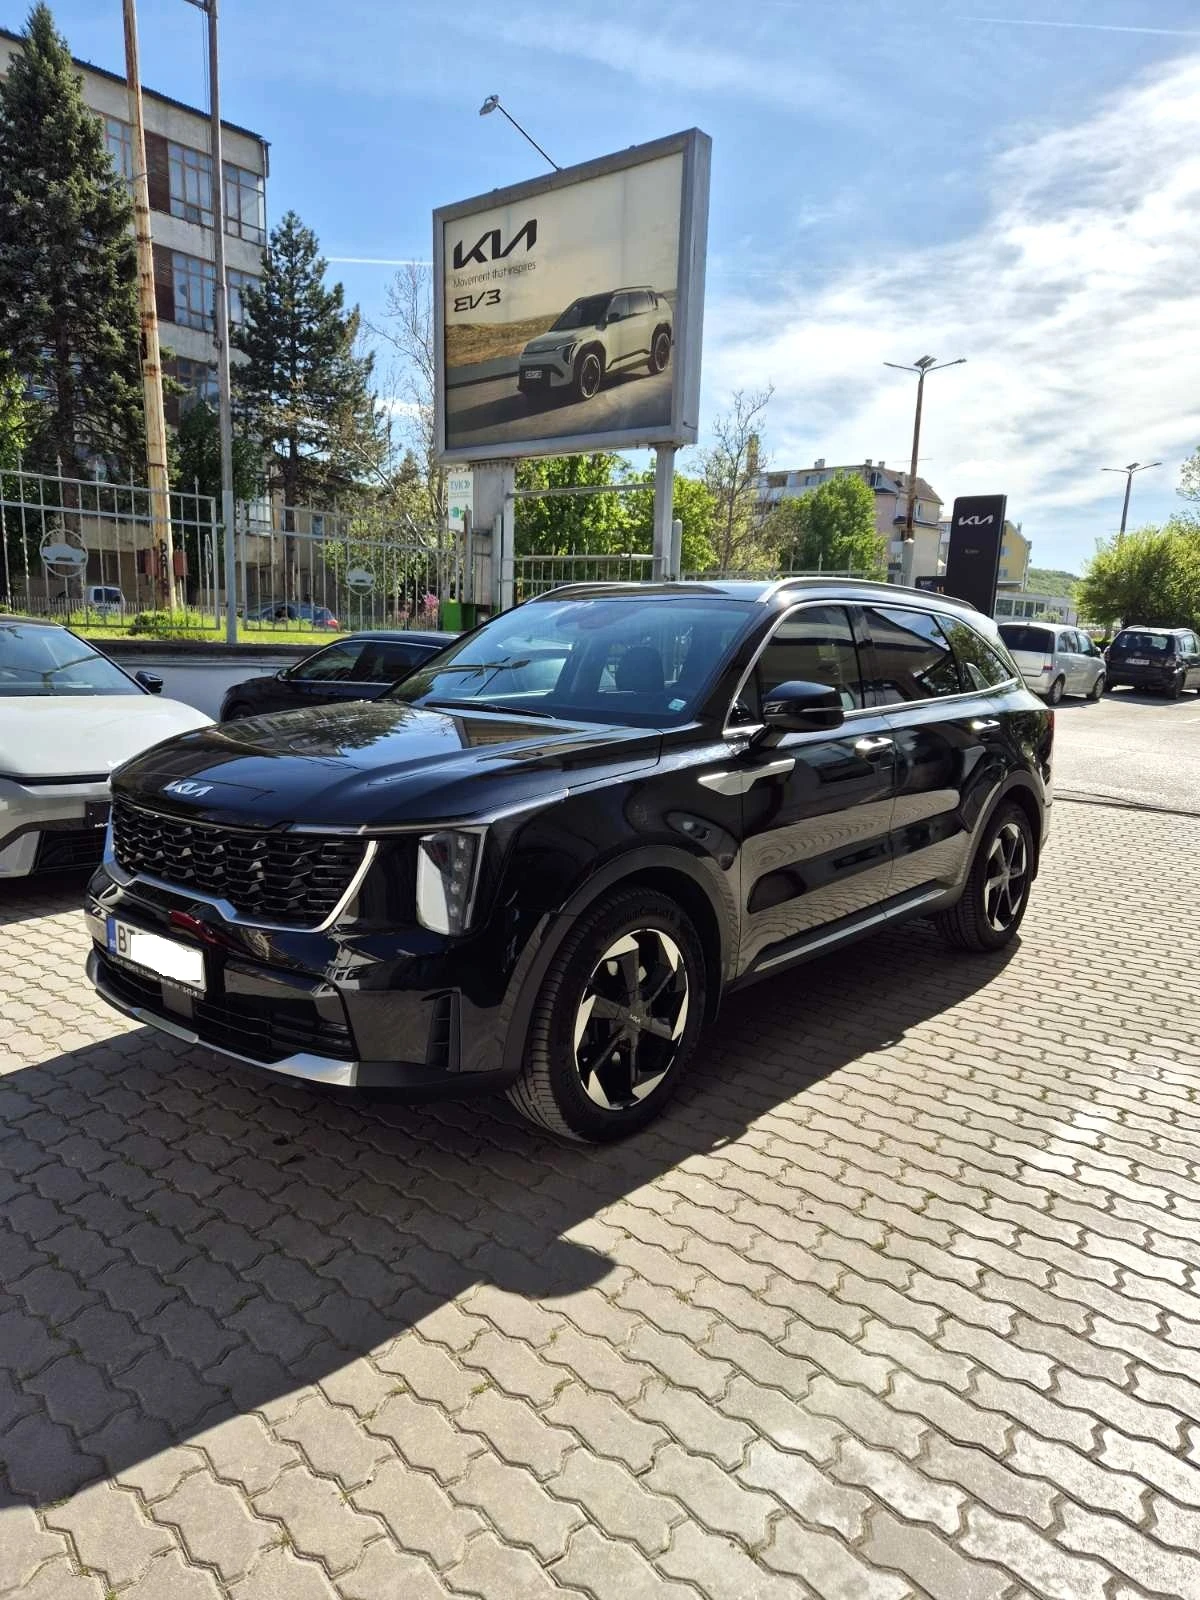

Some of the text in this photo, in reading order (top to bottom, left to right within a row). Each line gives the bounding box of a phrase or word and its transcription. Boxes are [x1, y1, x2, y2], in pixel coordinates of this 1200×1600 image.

[453, 218, 537, 270] KIA
[453, 261, 537, 287] Movement that inspires
[453, 288, 501, 312] EV3
[958, 514, 994, 526] KIA
[163, 779, 214, 798] KIA
